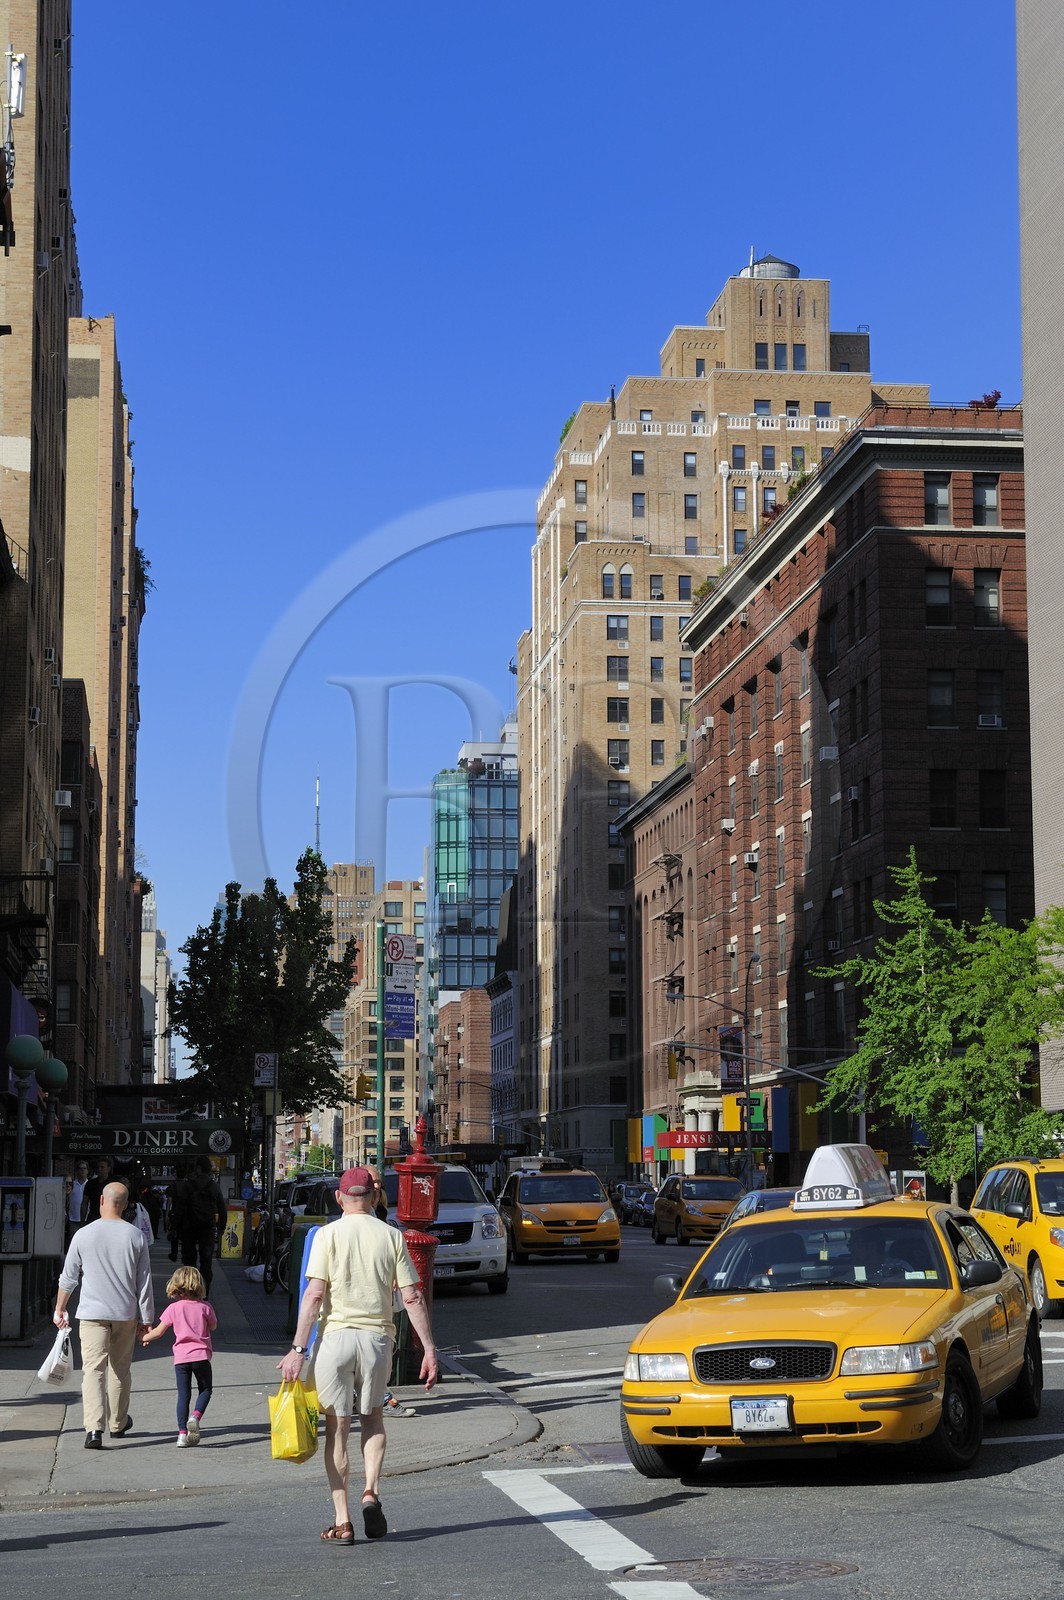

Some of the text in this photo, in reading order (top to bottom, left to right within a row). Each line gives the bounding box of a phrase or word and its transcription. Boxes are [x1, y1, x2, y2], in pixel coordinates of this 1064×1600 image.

[112, 1130, 199, 1147] DINER
[69, 1142, 102, 1150] 691-5200
[813, 1187, 842, 1200] 8Y62
